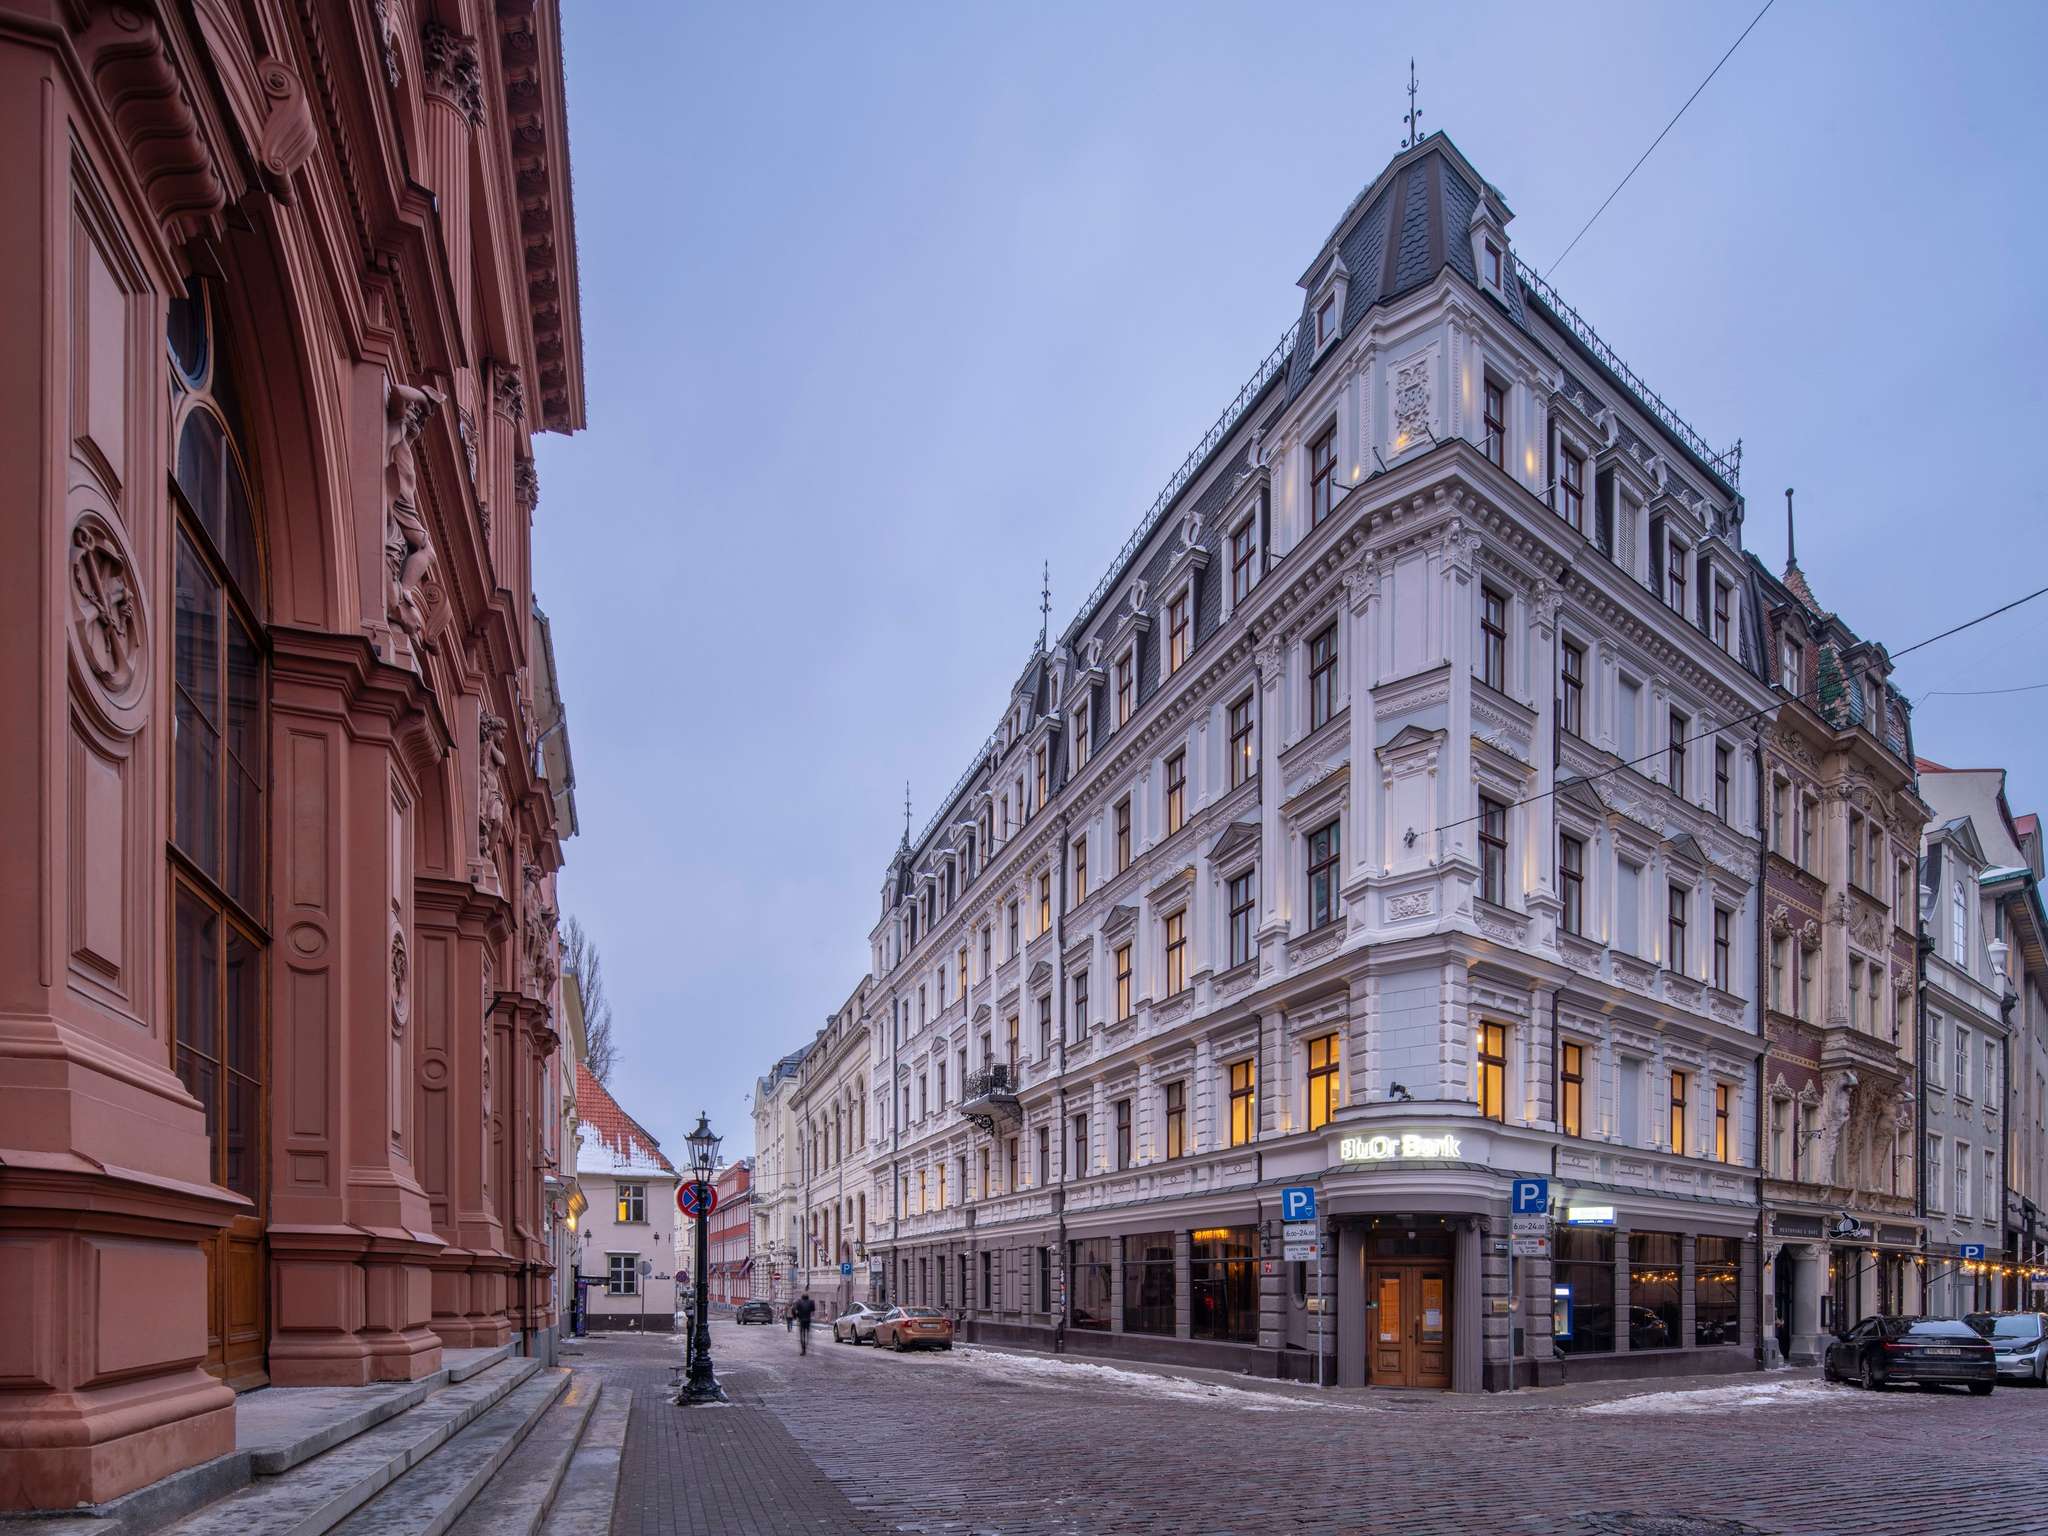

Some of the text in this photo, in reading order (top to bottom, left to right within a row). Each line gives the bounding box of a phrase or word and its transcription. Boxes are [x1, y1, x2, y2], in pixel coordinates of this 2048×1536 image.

[1401, 1134, 1462, 1159] Bank
[1289, 1192, 1308, 1216] P
[1520, 1184, 1540, 1209] P
[1965, 1246, 1980, 1259] P
[844, 1263, 851, 1274] P
